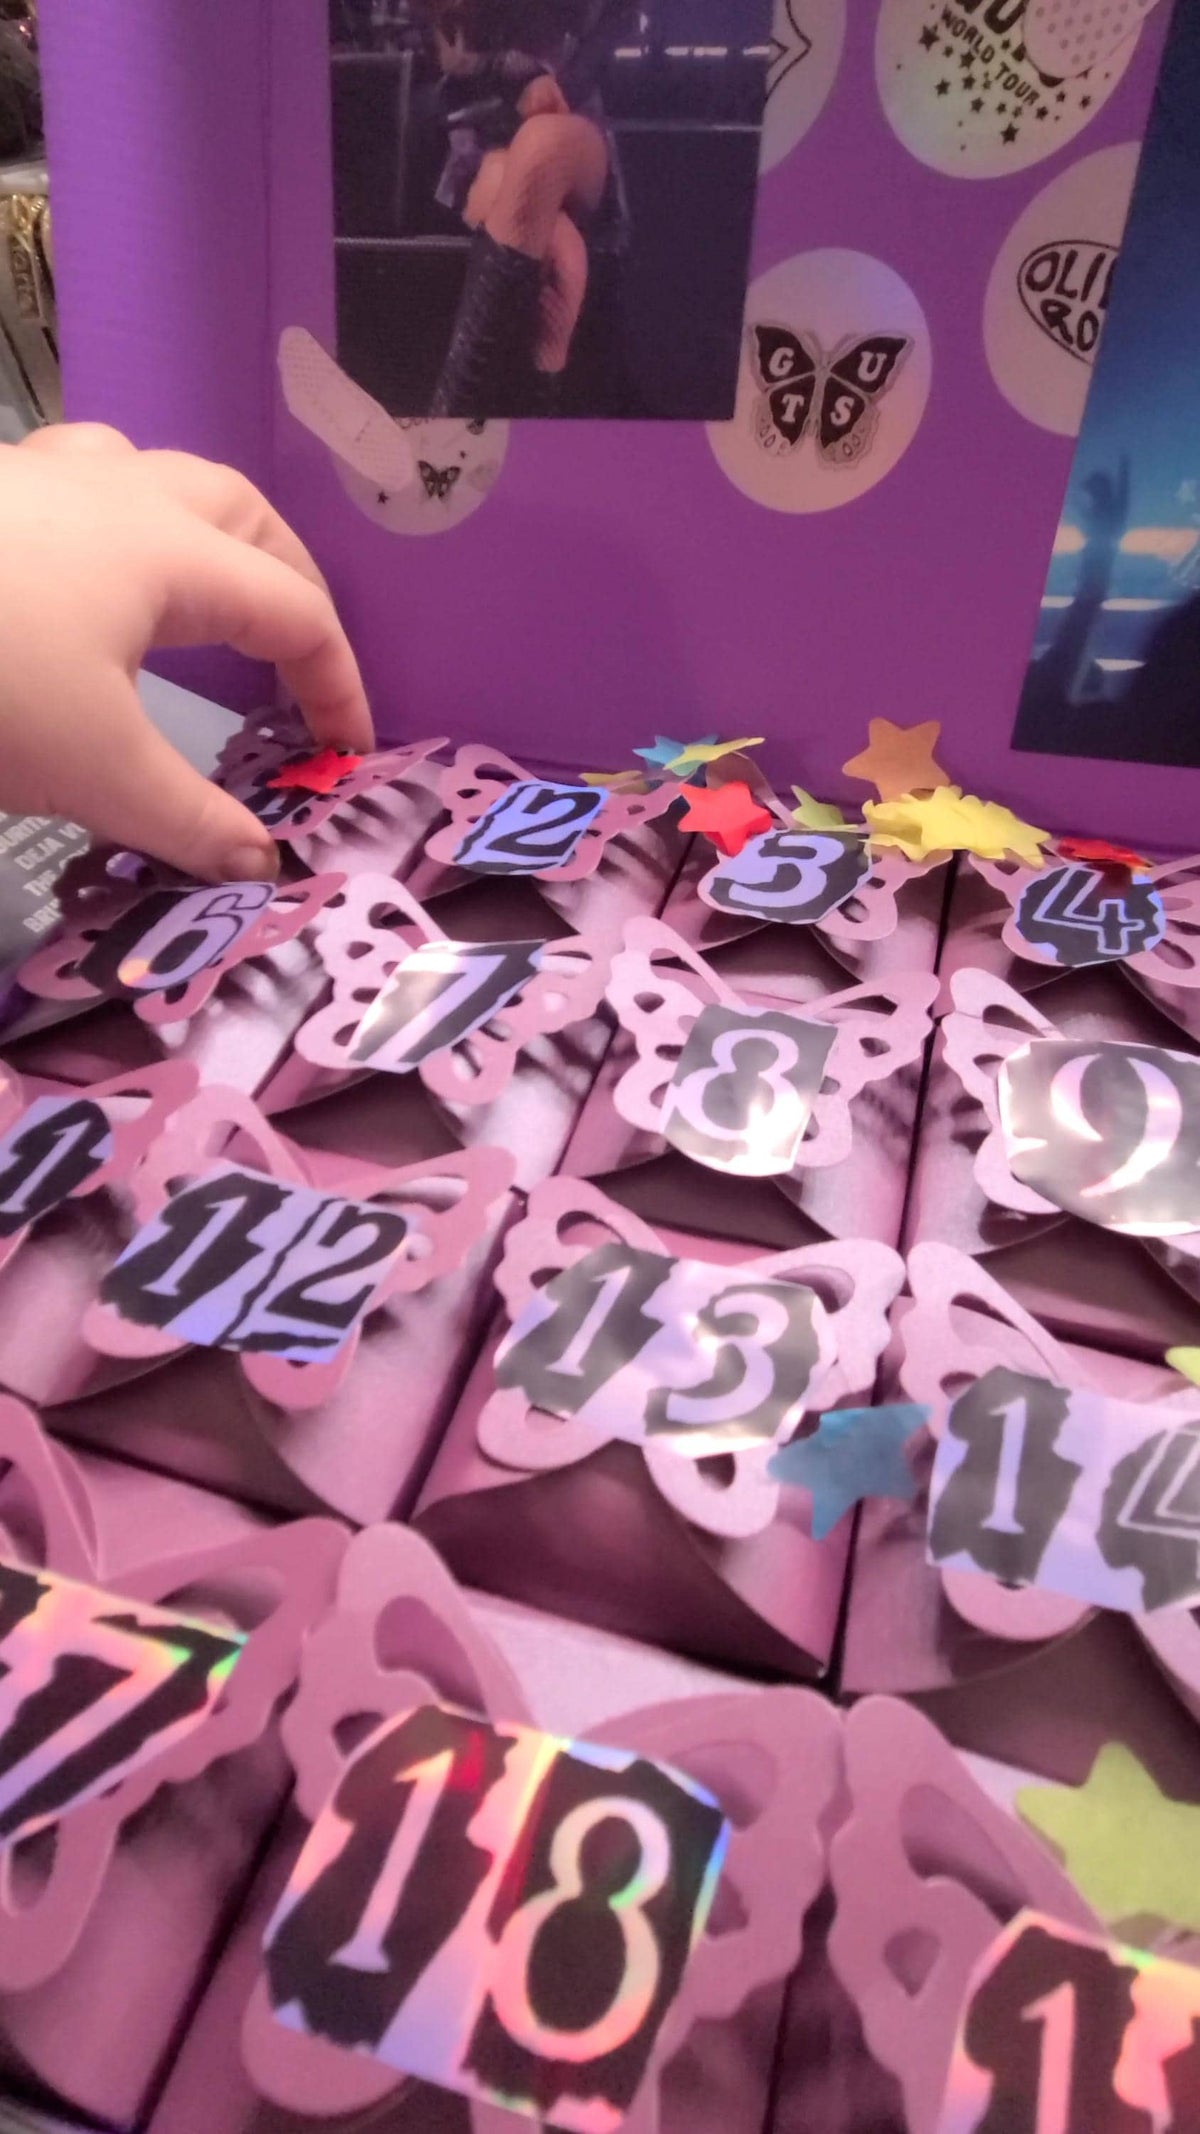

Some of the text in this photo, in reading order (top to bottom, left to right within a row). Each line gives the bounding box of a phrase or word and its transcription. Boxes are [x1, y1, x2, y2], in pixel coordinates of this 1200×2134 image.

[941, 5, 995, 63] WORLD
[995, 61, 1040, 106] TOUR
[485, 788, 601, 857] 2
[728, 834, 845, 908] 3
[117, 881, 278, 990] 6
[1032, 863, 1146, 955] 4
[364, 951, 508, 1072] 7
[677, 1028, 801, 1145] 8
[1050, 1053, 1183, 1198] 9
[140, 1195, 408, 1330] 12
[543, 1264, 790, 1424] 13
[329, 1749, 672, 2063] 18
